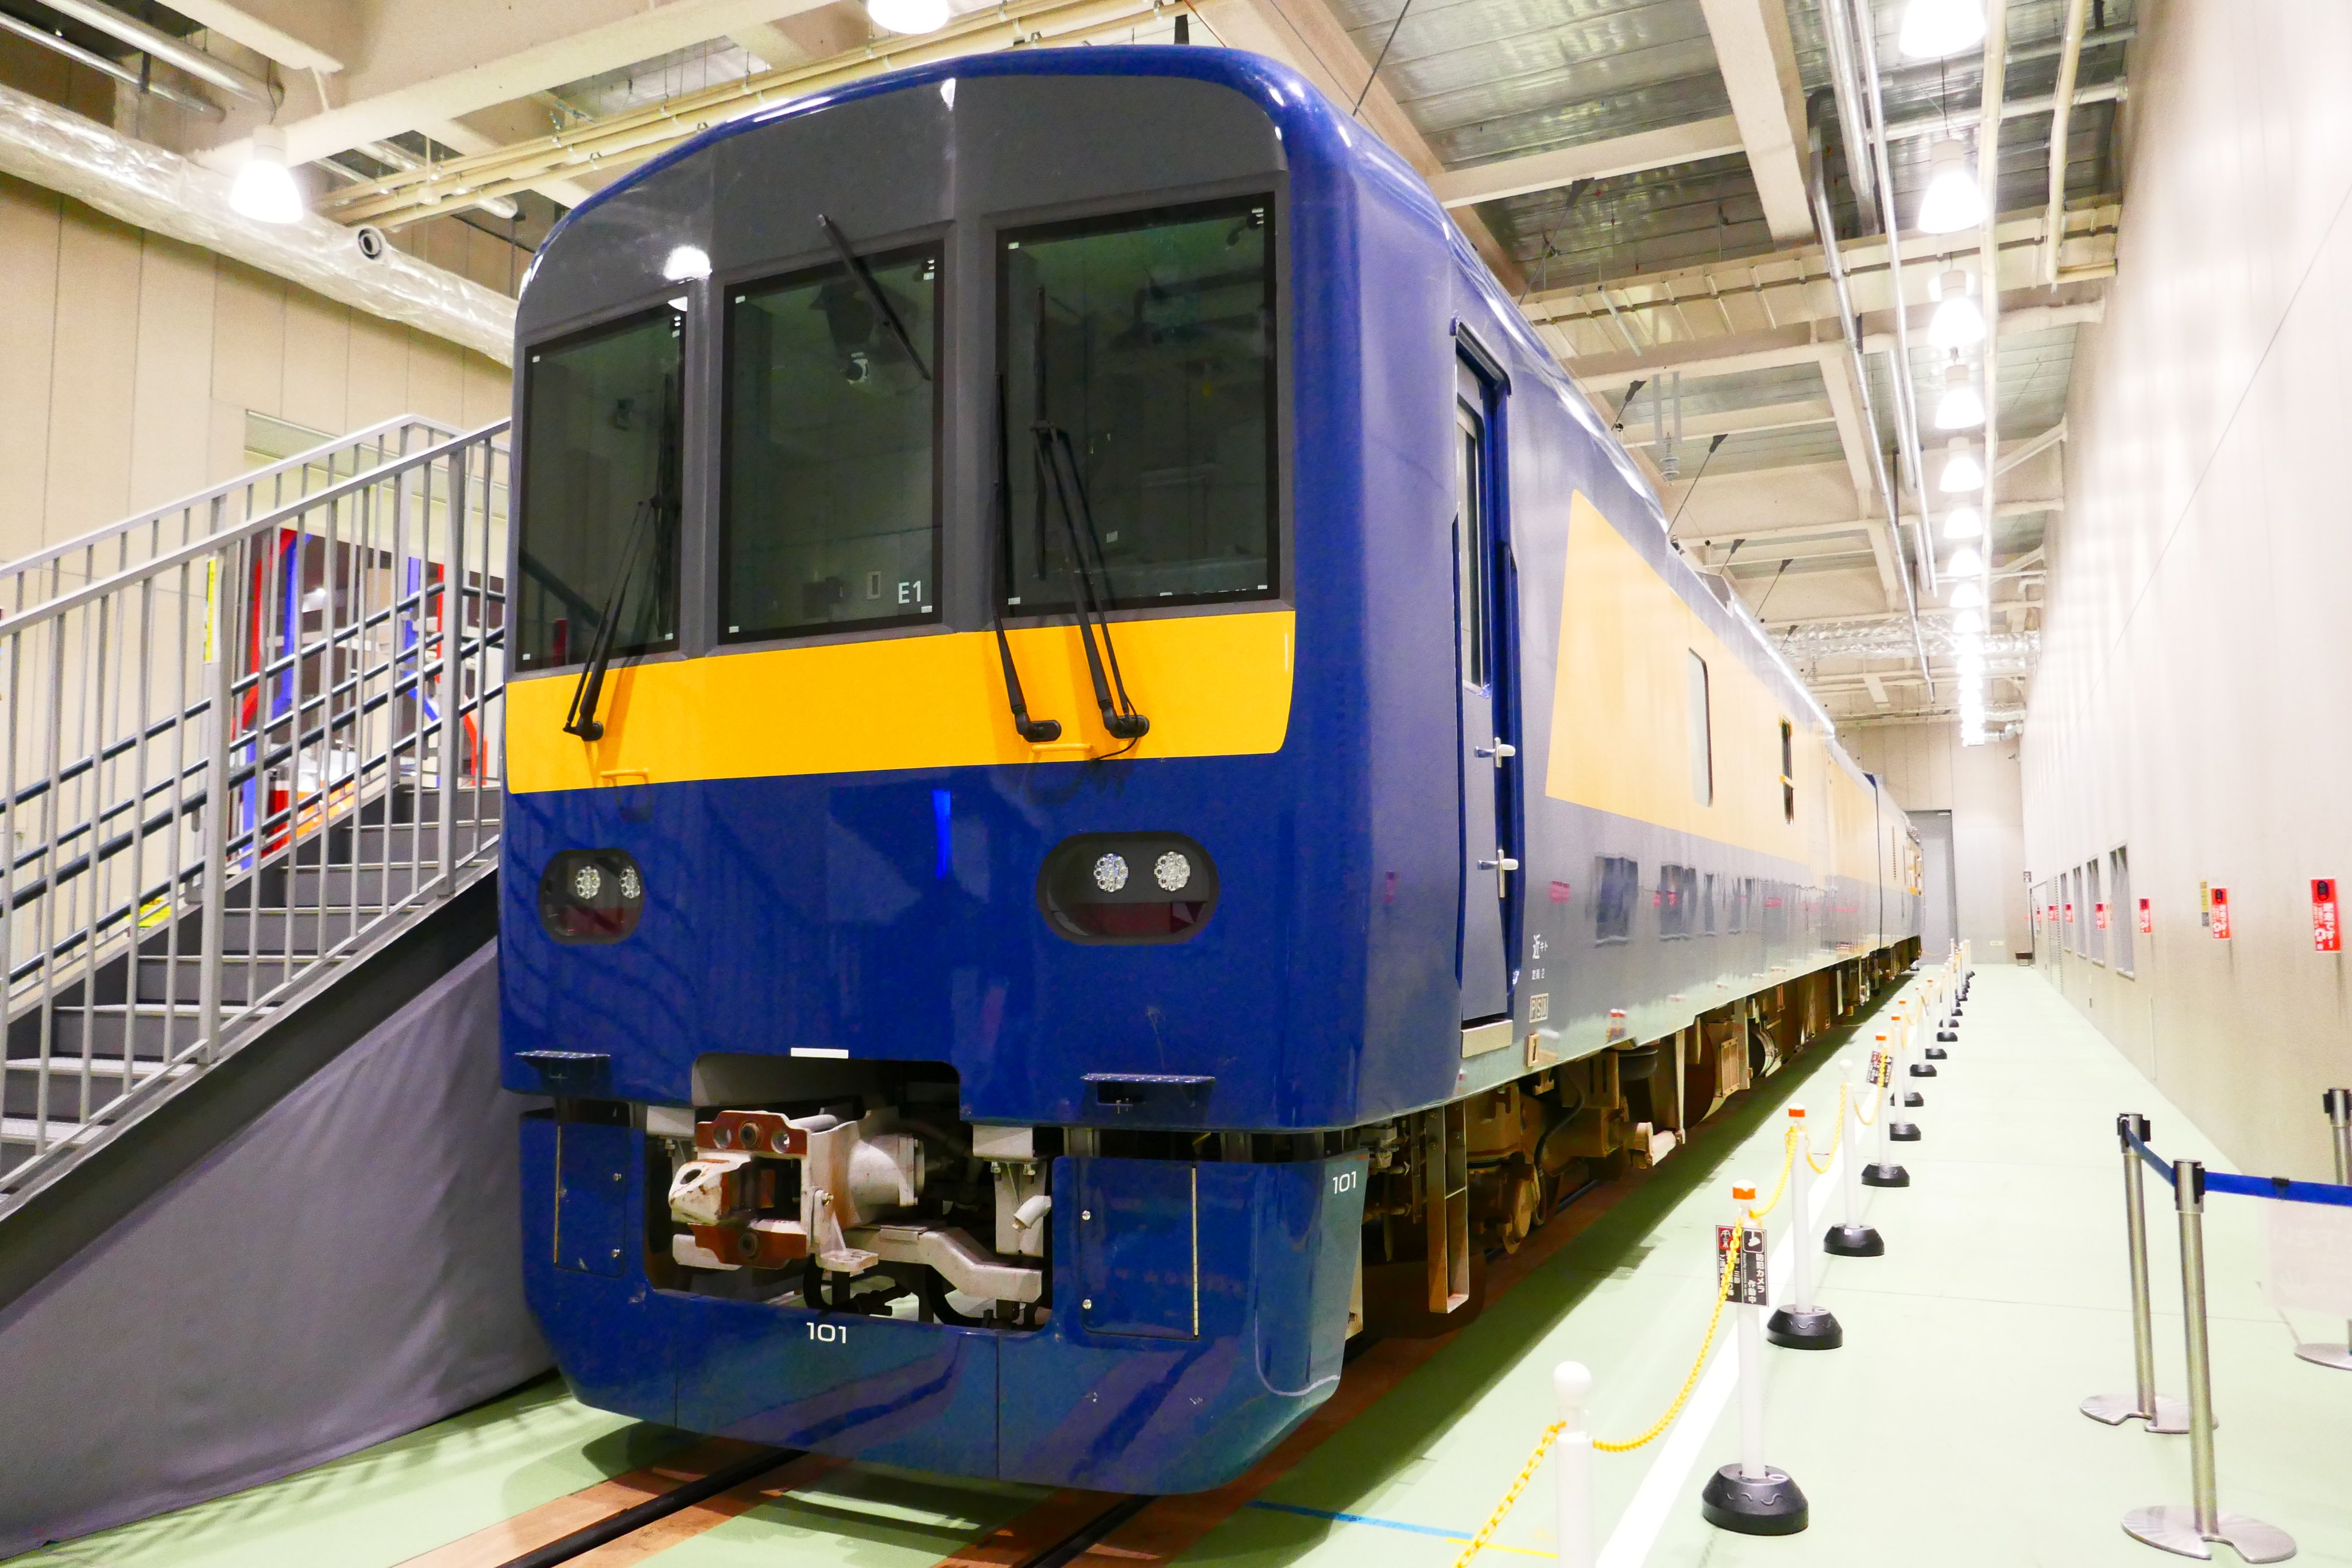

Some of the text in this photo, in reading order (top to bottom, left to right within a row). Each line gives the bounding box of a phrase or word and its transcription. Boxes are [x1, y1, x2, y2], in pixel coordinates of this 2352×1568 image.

[899, 580, 921, 603] E1
[1333, 1171, 1356, 1194] 101
[1756, 1253, 1765, 1293] 防犯カメラ
[806, 1322, 846, 1344] 101
